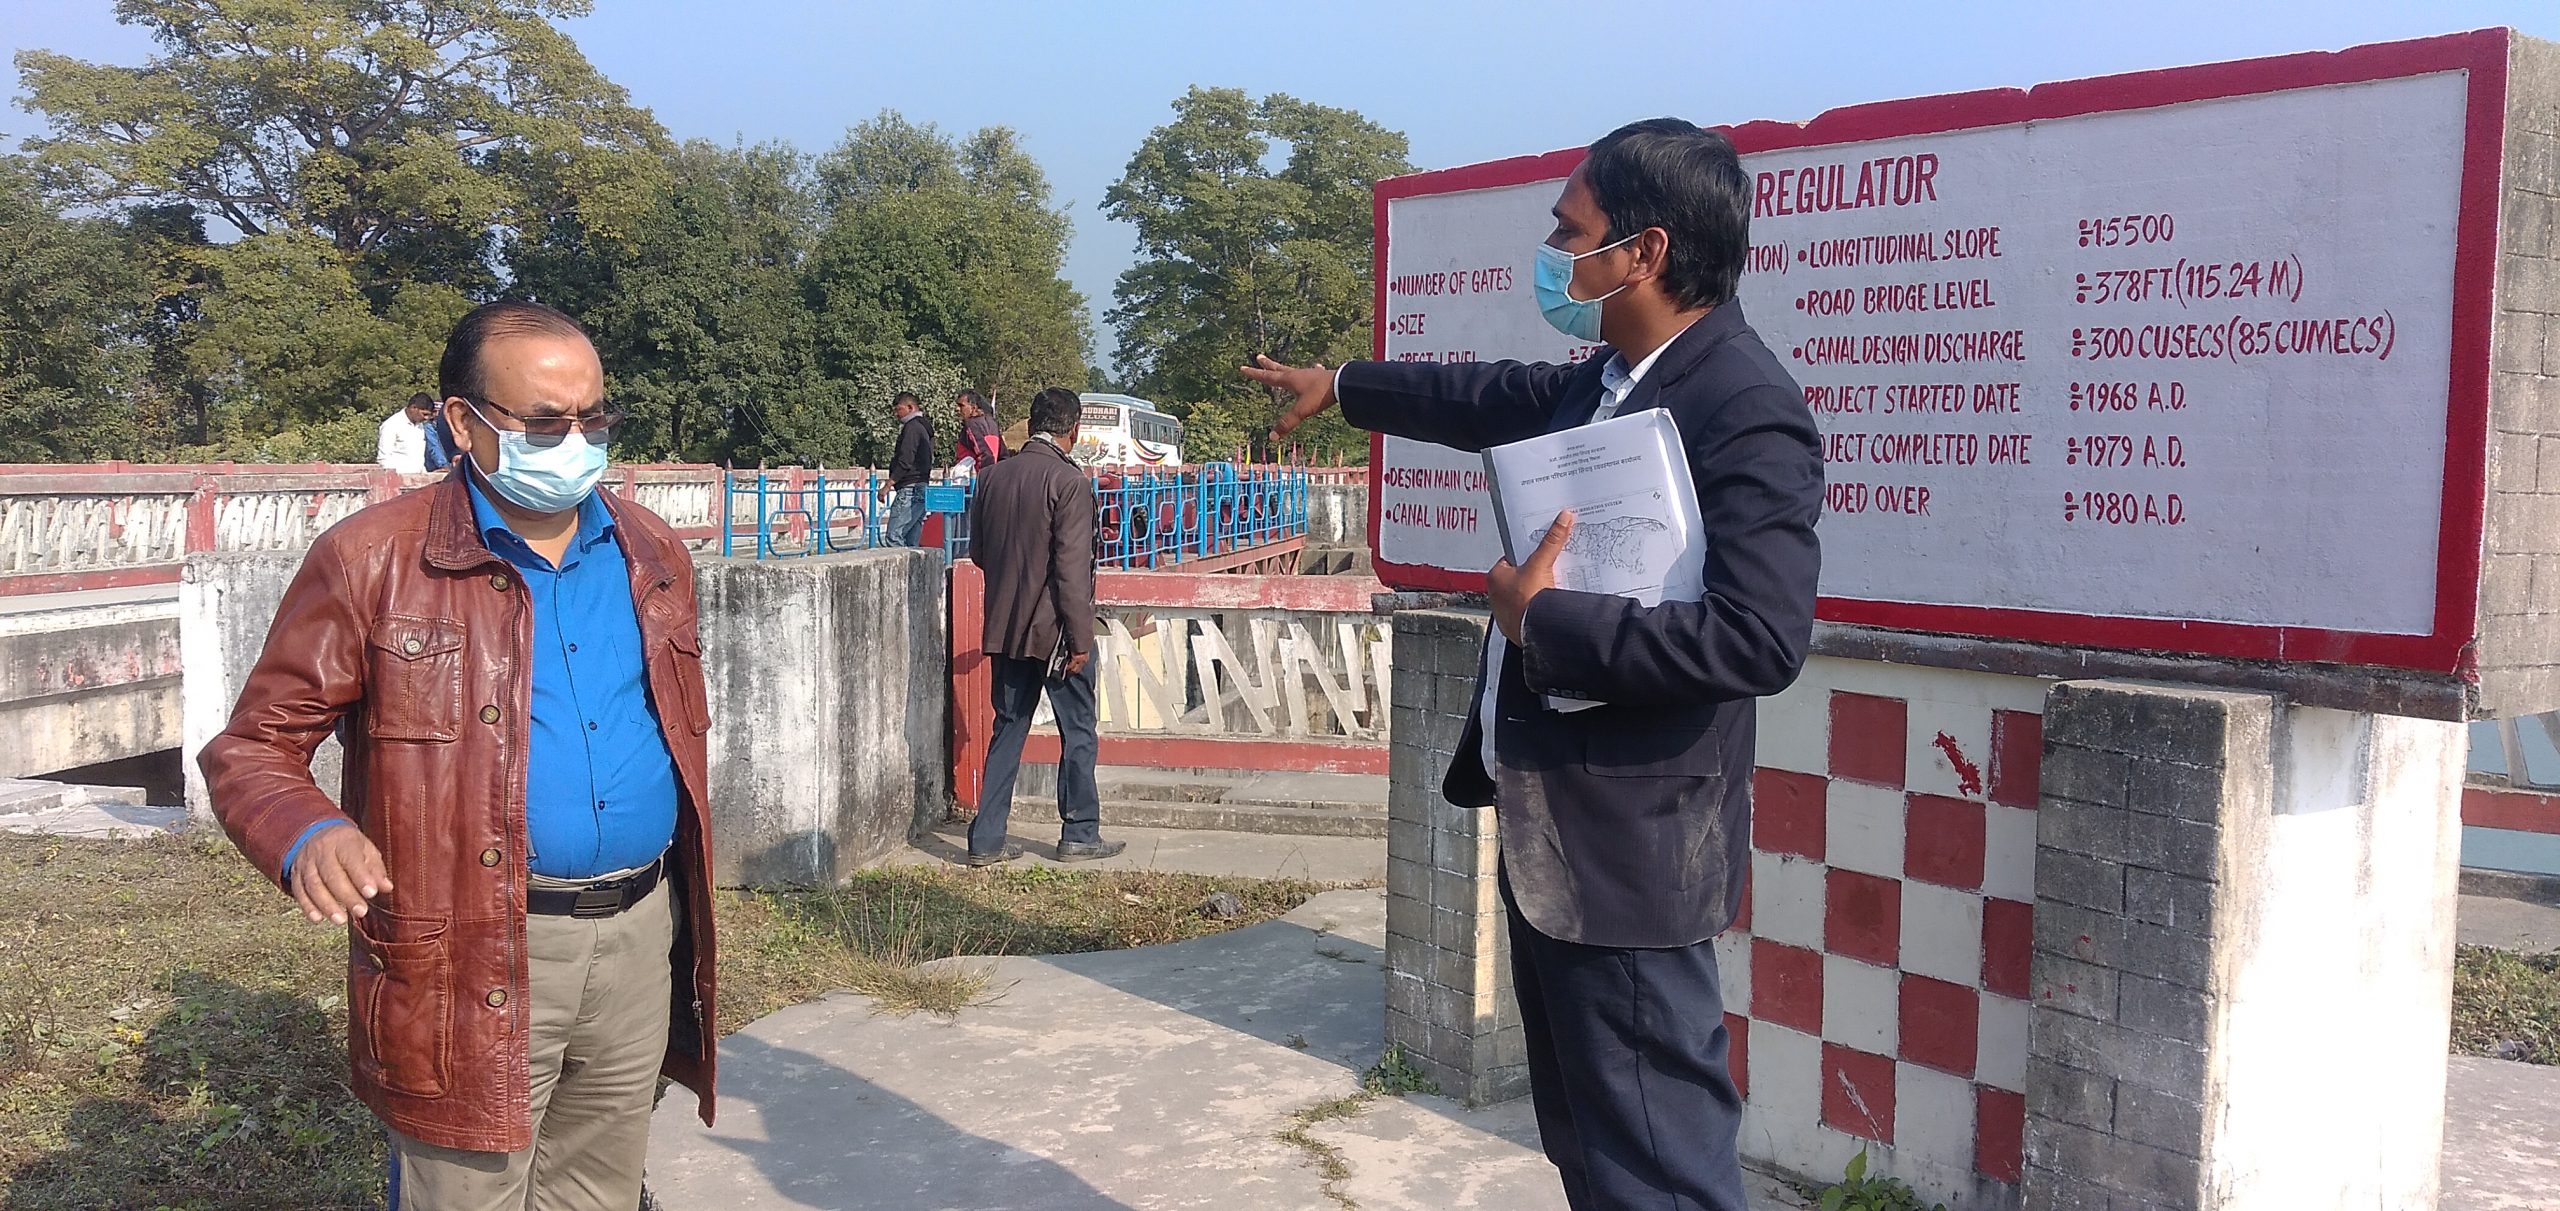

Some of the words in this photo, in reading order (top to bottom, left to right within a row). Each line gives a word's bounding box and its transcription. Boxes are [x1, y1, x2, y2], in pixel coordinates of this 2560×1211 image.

[1754, 152, 1940, 219] REGULATOR
[1809, 232, 1939, 269] LONGITUDINAL
[1941, 226, 2001, 261] SLOPE
[1397, 272, 1446, 296] NUMBER
[1448, 270, 1468, 295] OF
[1471, 267, 1513, 294] GATES
[1807, 288, 1856, 318] ROAD
[1863, 282, 1928, 315] BRIDGE
[1933, 278, 1996, 311] LEVEL
[1397, 313, 1425, 336] SIZE
[1804, 335, 1861, 366] CANAL
[1861, 335, 1920, 367] DESIGN
[1923, 329, 2026, 364] DISCHARGE
[1804, 385, 1878, 414] PROJECT
[1883, 383, 1966, 415] STARTED
[1972, 382, 2021, 414] DATE
[2147, 381, 2187, 413] A.D.
[1870, 433, 1979, 466] COMPLETED
[1988, 433, 2032, 465] DATE
[2142, 434, 2186, 468] A.D.
[1389, 466, 1432, 490] DESIGN
[1433, 469, 1461, 490] MAIN
[1463, 470, 1490, 492] CAN
[1392, 503, 1432, 528] CANAL
[1436, 506, 1478, 532] WIDTH
[1874, 485, 1931, 517] OVER
[2143, 493, 2186, 526] A.D.
